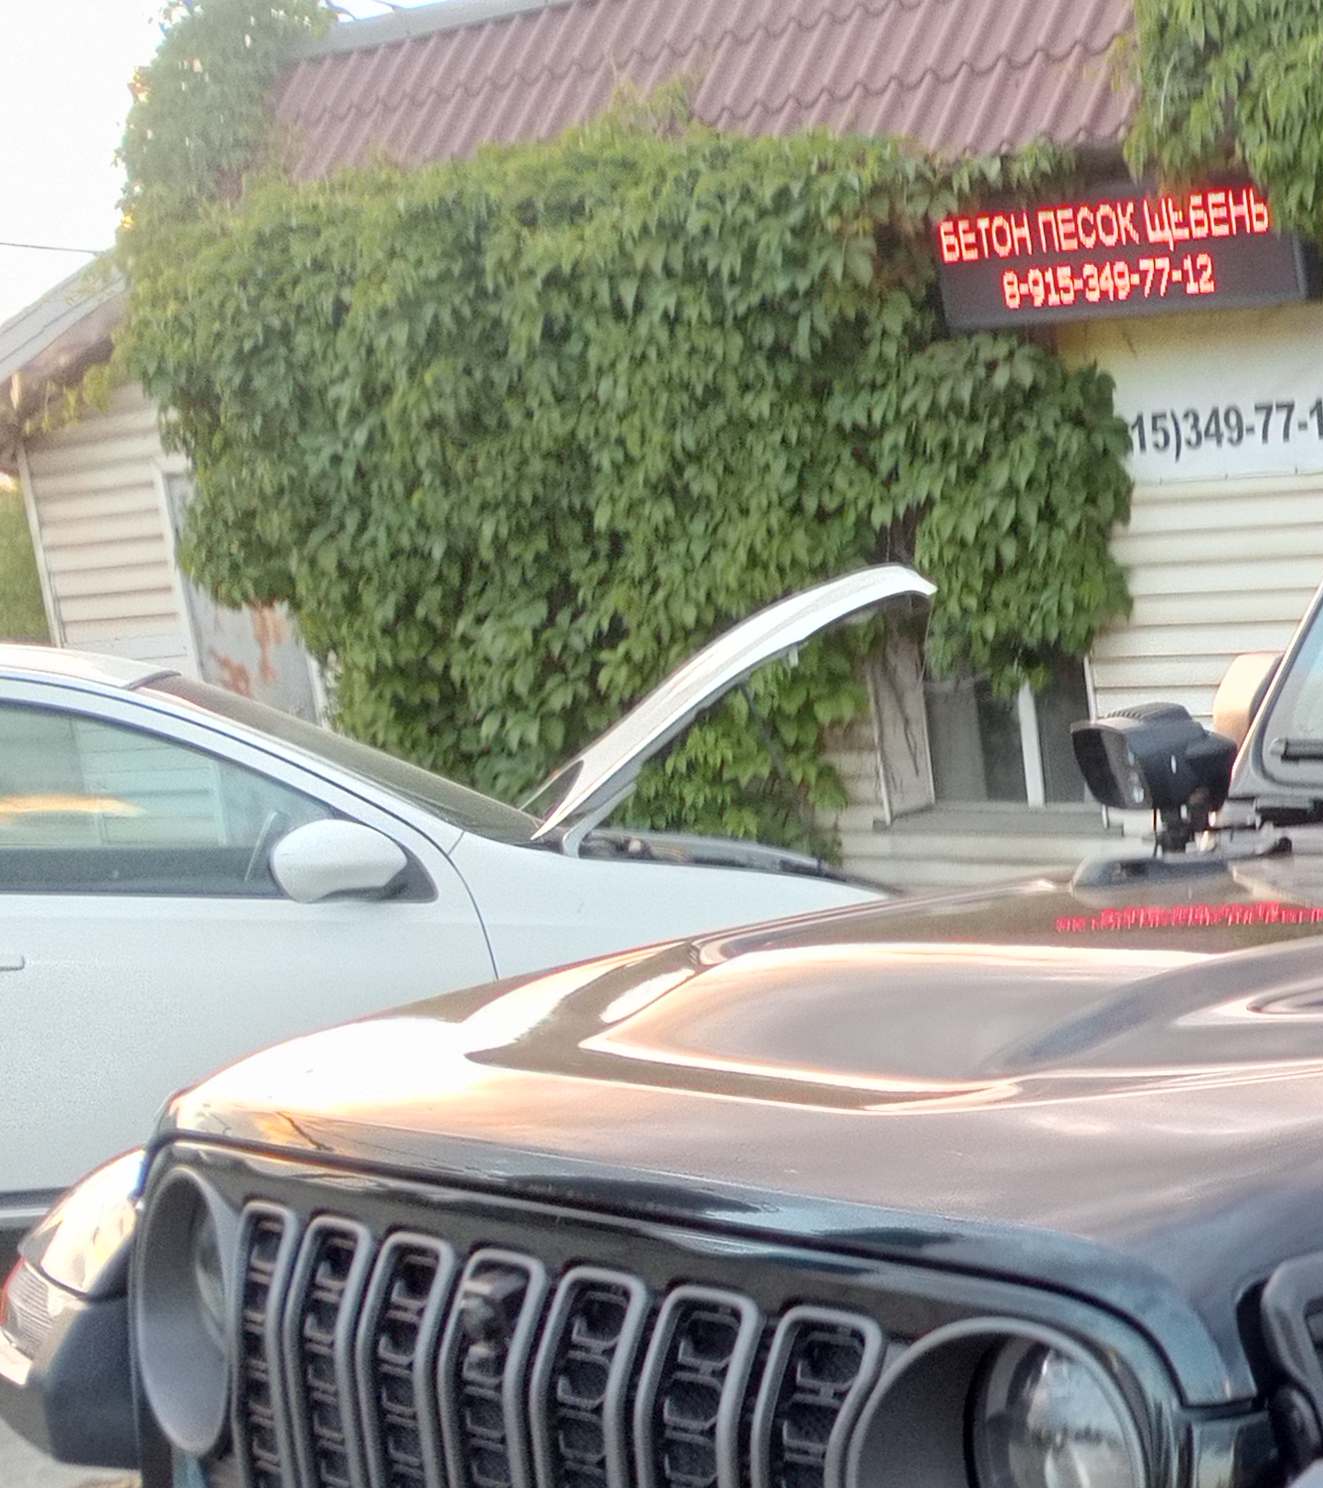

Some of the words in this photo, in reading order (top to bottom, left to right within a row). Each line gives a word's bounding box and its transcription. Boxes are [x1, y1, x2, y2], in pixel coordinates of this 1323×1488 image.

[940, 213, 1032, 262] БЕТОН
[1038, 201, 1140, 253] ПЕСОК
[1143, 188, 1268, 251] ЩЕБЕНЬ
[1003, 253, 1215, 310] 8-915-349-77-12
